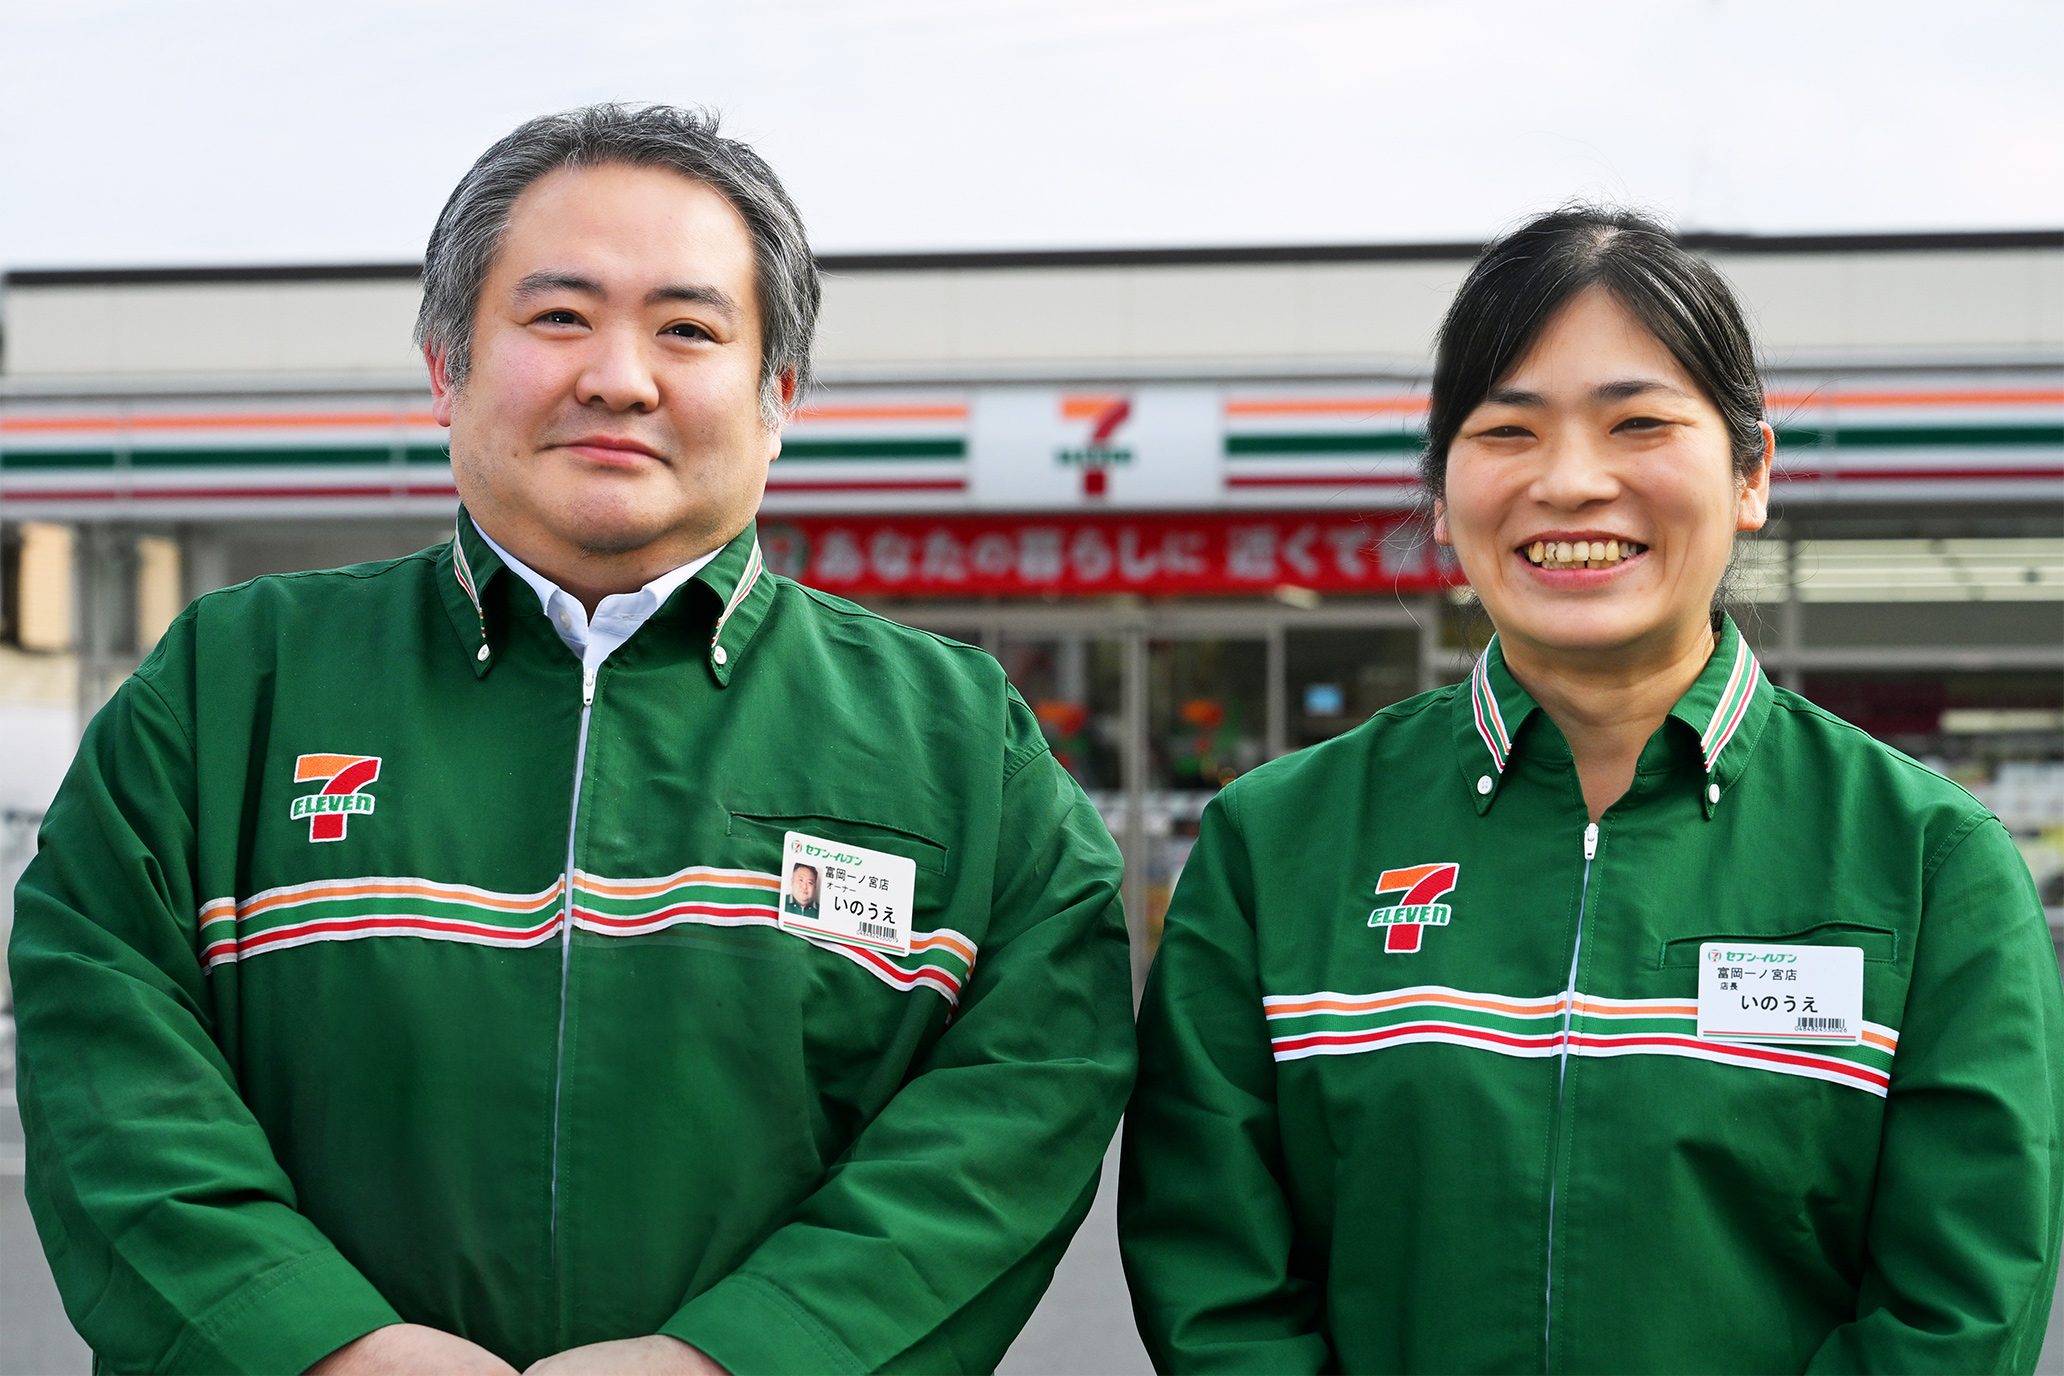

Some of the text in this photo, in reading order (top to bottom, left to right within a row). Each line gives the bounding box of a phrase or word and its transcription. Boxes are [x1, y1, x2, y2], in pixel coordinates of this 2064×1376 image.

[294, 753, 382, 842] 7
[825, 866, 890, 891] 富岡一ノ宮店
[826, 881, 857, 893] オーナー
[834, 896, 896, 924] いのうえ
[1375, 863, 1459, 953] 7
[1717, 967, 1798, 981] 富岡一ノ宮店
[1720, 982, 1739, 991] 店長
[1741, 995, 1819, 1013] いのうえ
